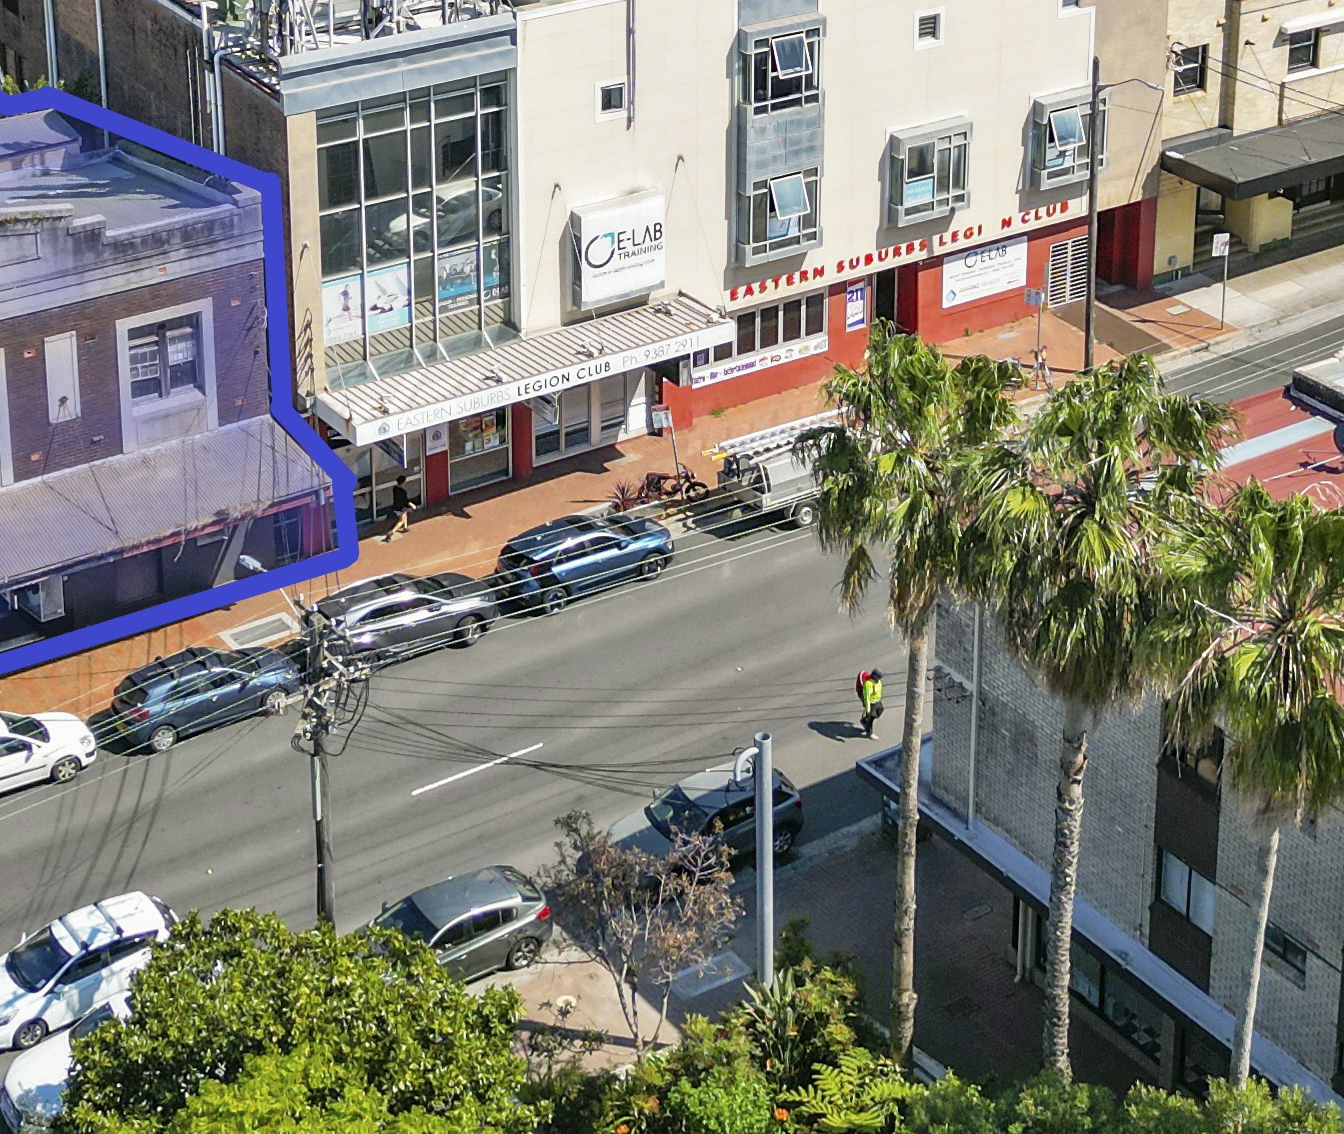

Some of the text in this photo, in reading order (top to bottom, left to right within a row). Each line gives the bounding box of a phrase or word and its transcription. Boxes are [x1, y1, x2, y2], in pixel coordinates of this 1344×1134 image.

[617, 222, 663, 251] E-LAB
[617, 242, 663, 260] TRAINING
[730, 265, 825, 301] EASTERN
[836, 238, 928, 273] SUBURBS
[1021, 200, 1069, 224] CLUB
[397, 407, 452, 430] EASTERN
[456, 388, 511, 414] SUBURBS
[517, 372, 570, 396] LEGION
[576, 361, 611, 379] CLUB
